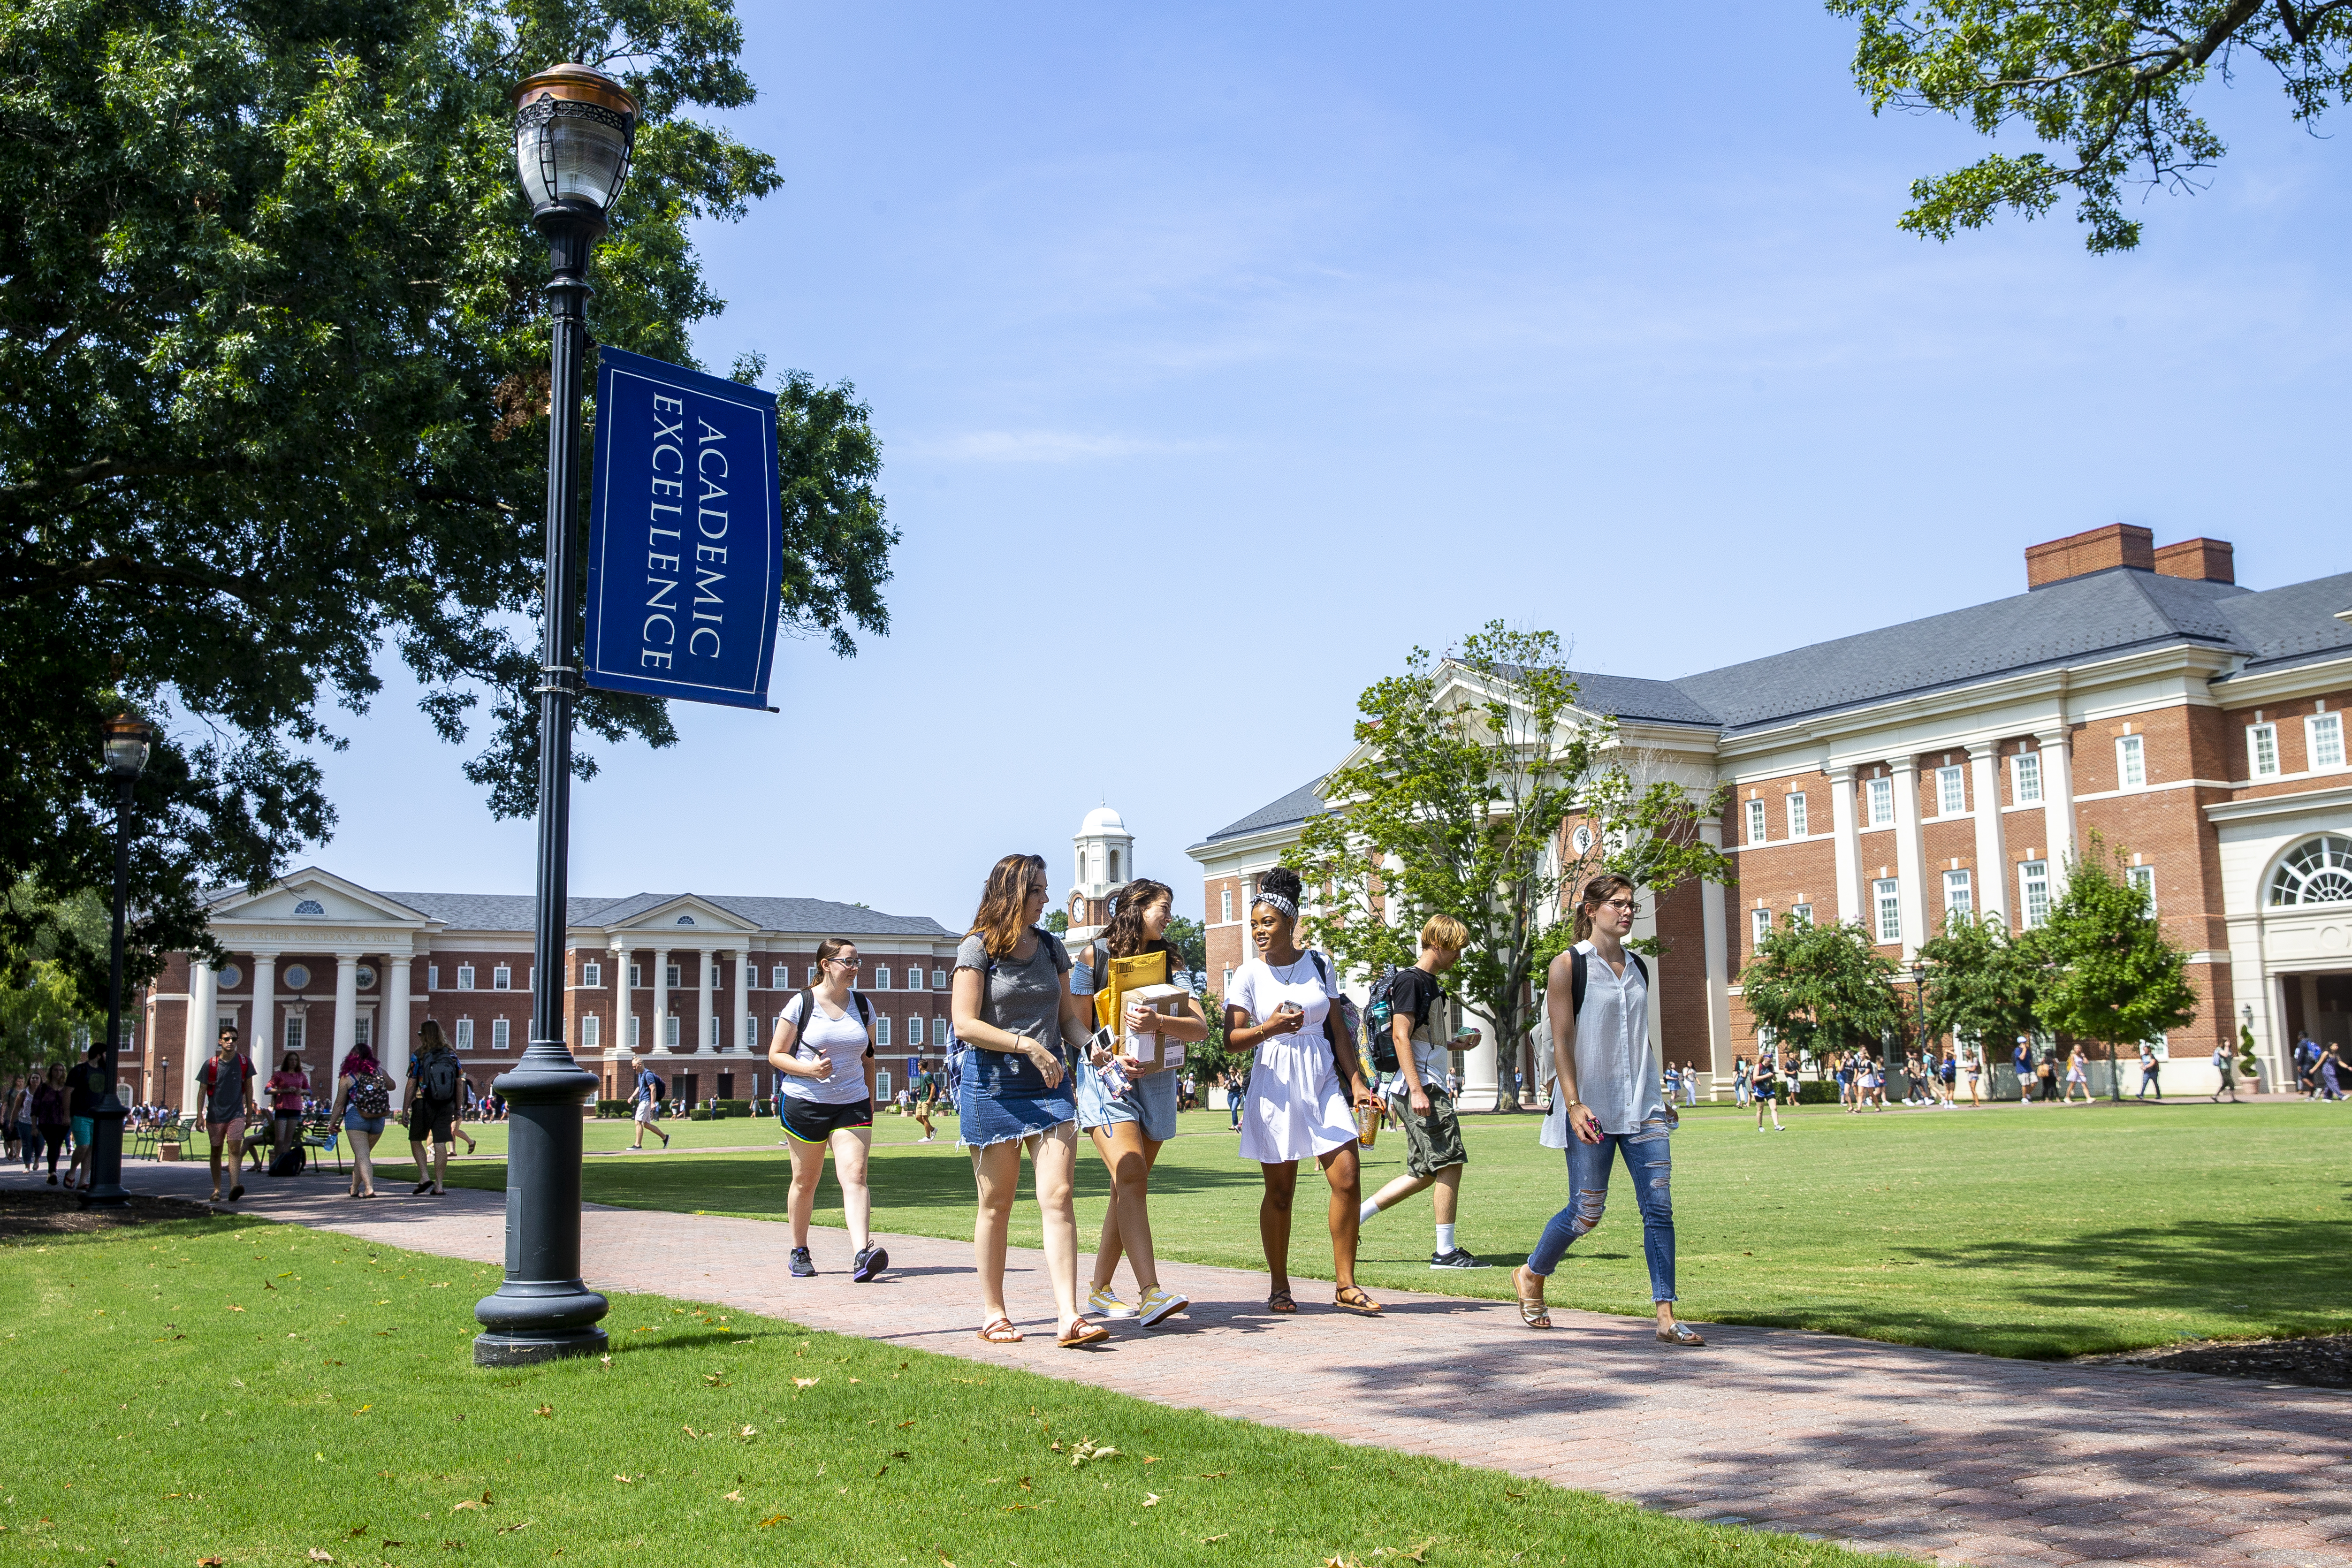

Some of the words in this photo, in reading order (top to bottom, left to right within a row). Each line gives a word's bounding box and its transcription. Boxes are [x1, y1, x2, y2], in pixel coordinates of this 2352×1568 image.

[641, 392, 683, 670] EXCELLENCE
[690, 416, 728, 658] ACADEMIC
[250, 932, 290, 940] ARCHER
